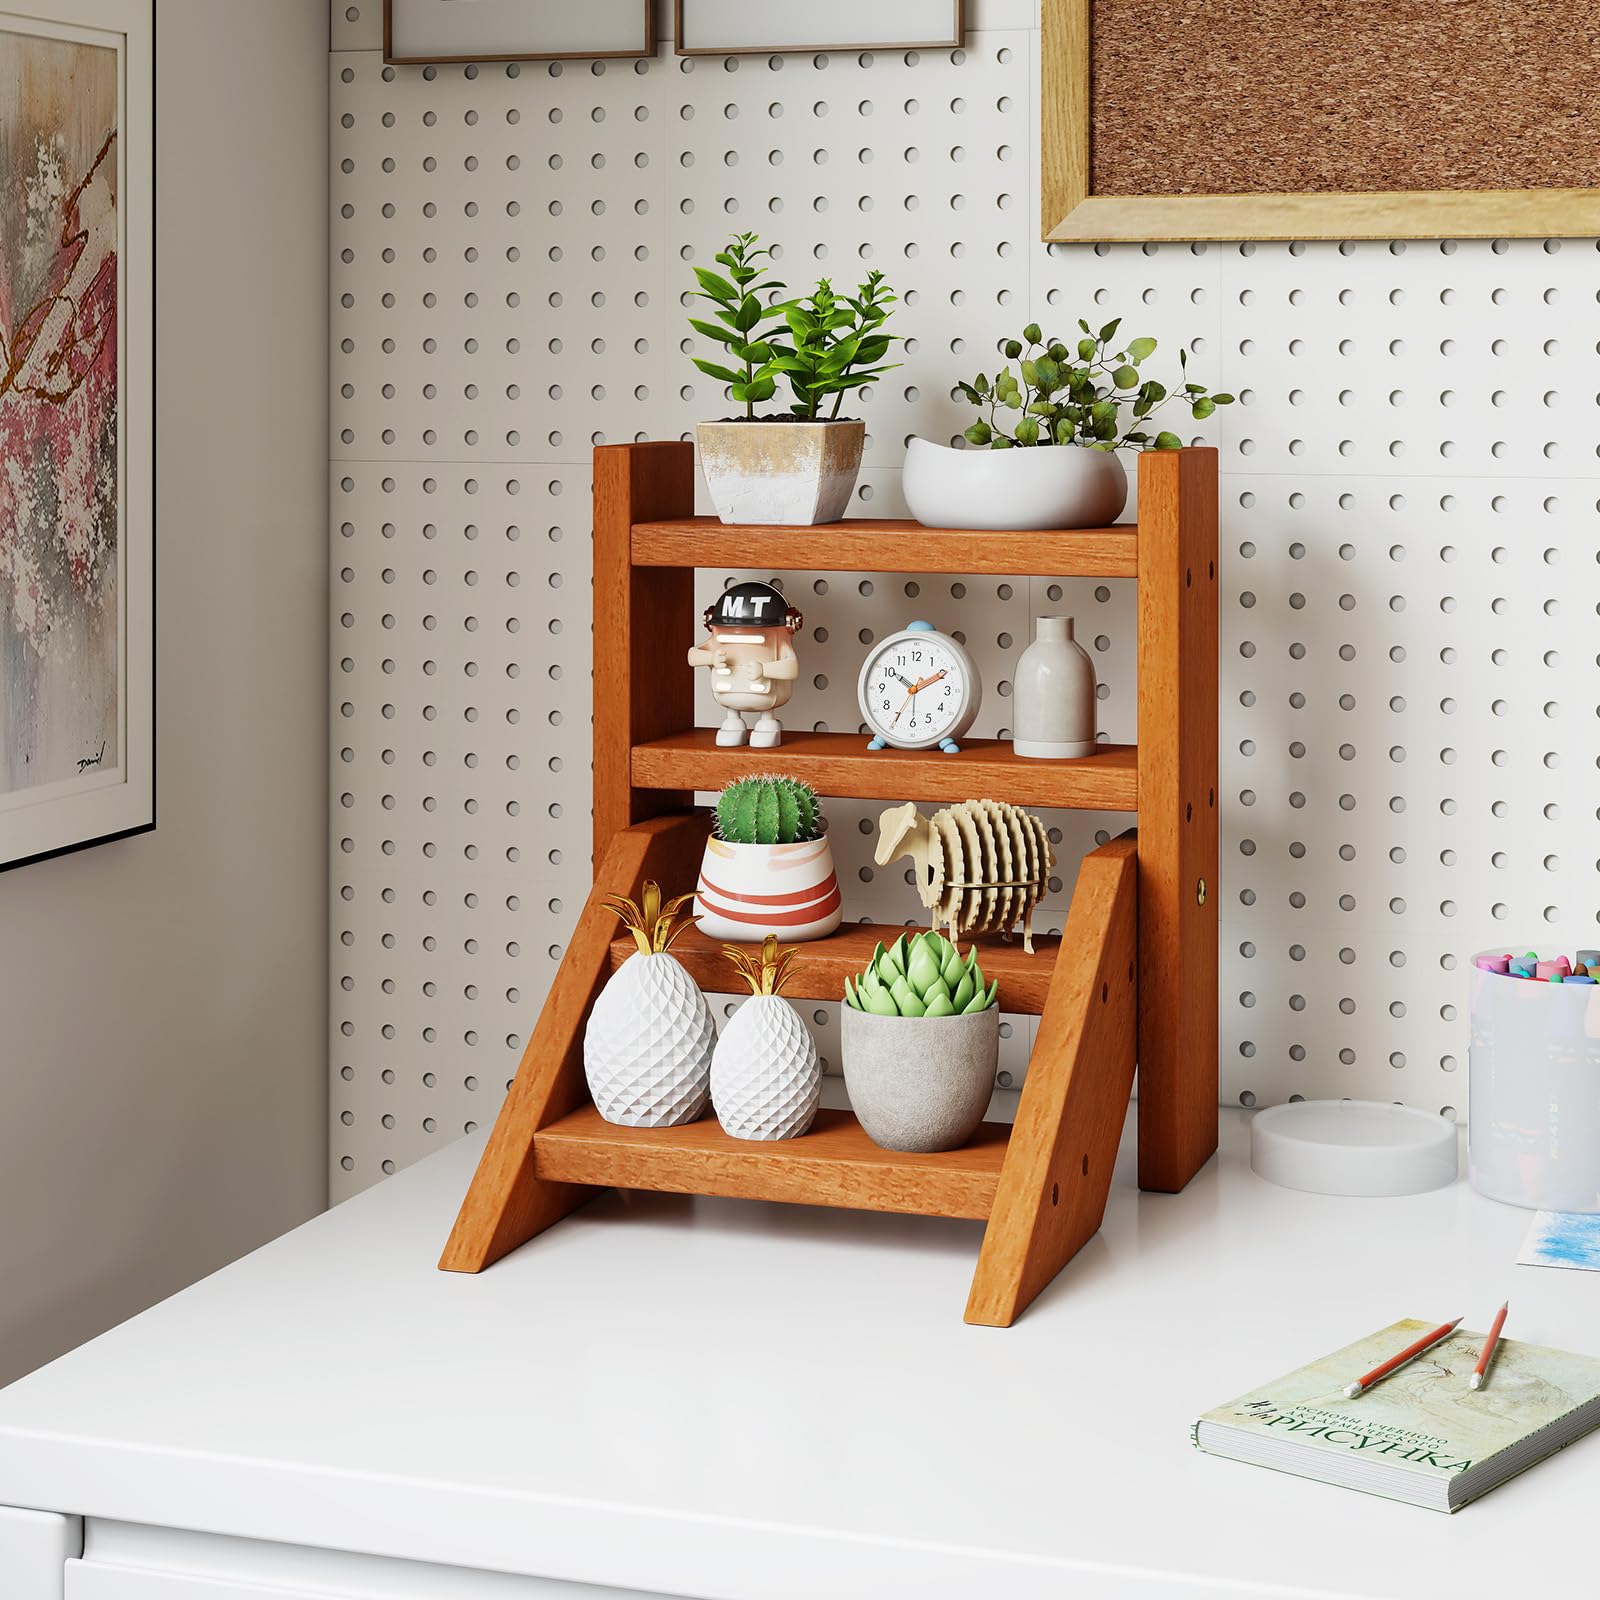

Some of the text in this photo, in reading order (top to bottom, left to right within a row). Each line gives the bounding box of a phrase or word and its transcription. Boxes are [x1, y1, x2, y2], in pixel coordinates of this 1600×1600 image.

[721, 595, 772, 618] MT
[897, 655, 906, 666] 11
[911, 651, 922, 662] 12
[930, 656, 934, 667] 1
[884, 667, 896, 678] 10
[878, 682, 886, 694] 9
[944, 685, 951, 696] 3
[882, 699, 890, 710] 8
[937, 702, 944, 712] 4
[895, 711, 901, 722] 7
[925, 713, 932, 724] 5
[909, 717, 917, 728] 6
[1264, 1414, 1473, 1473] РИСУНКА
